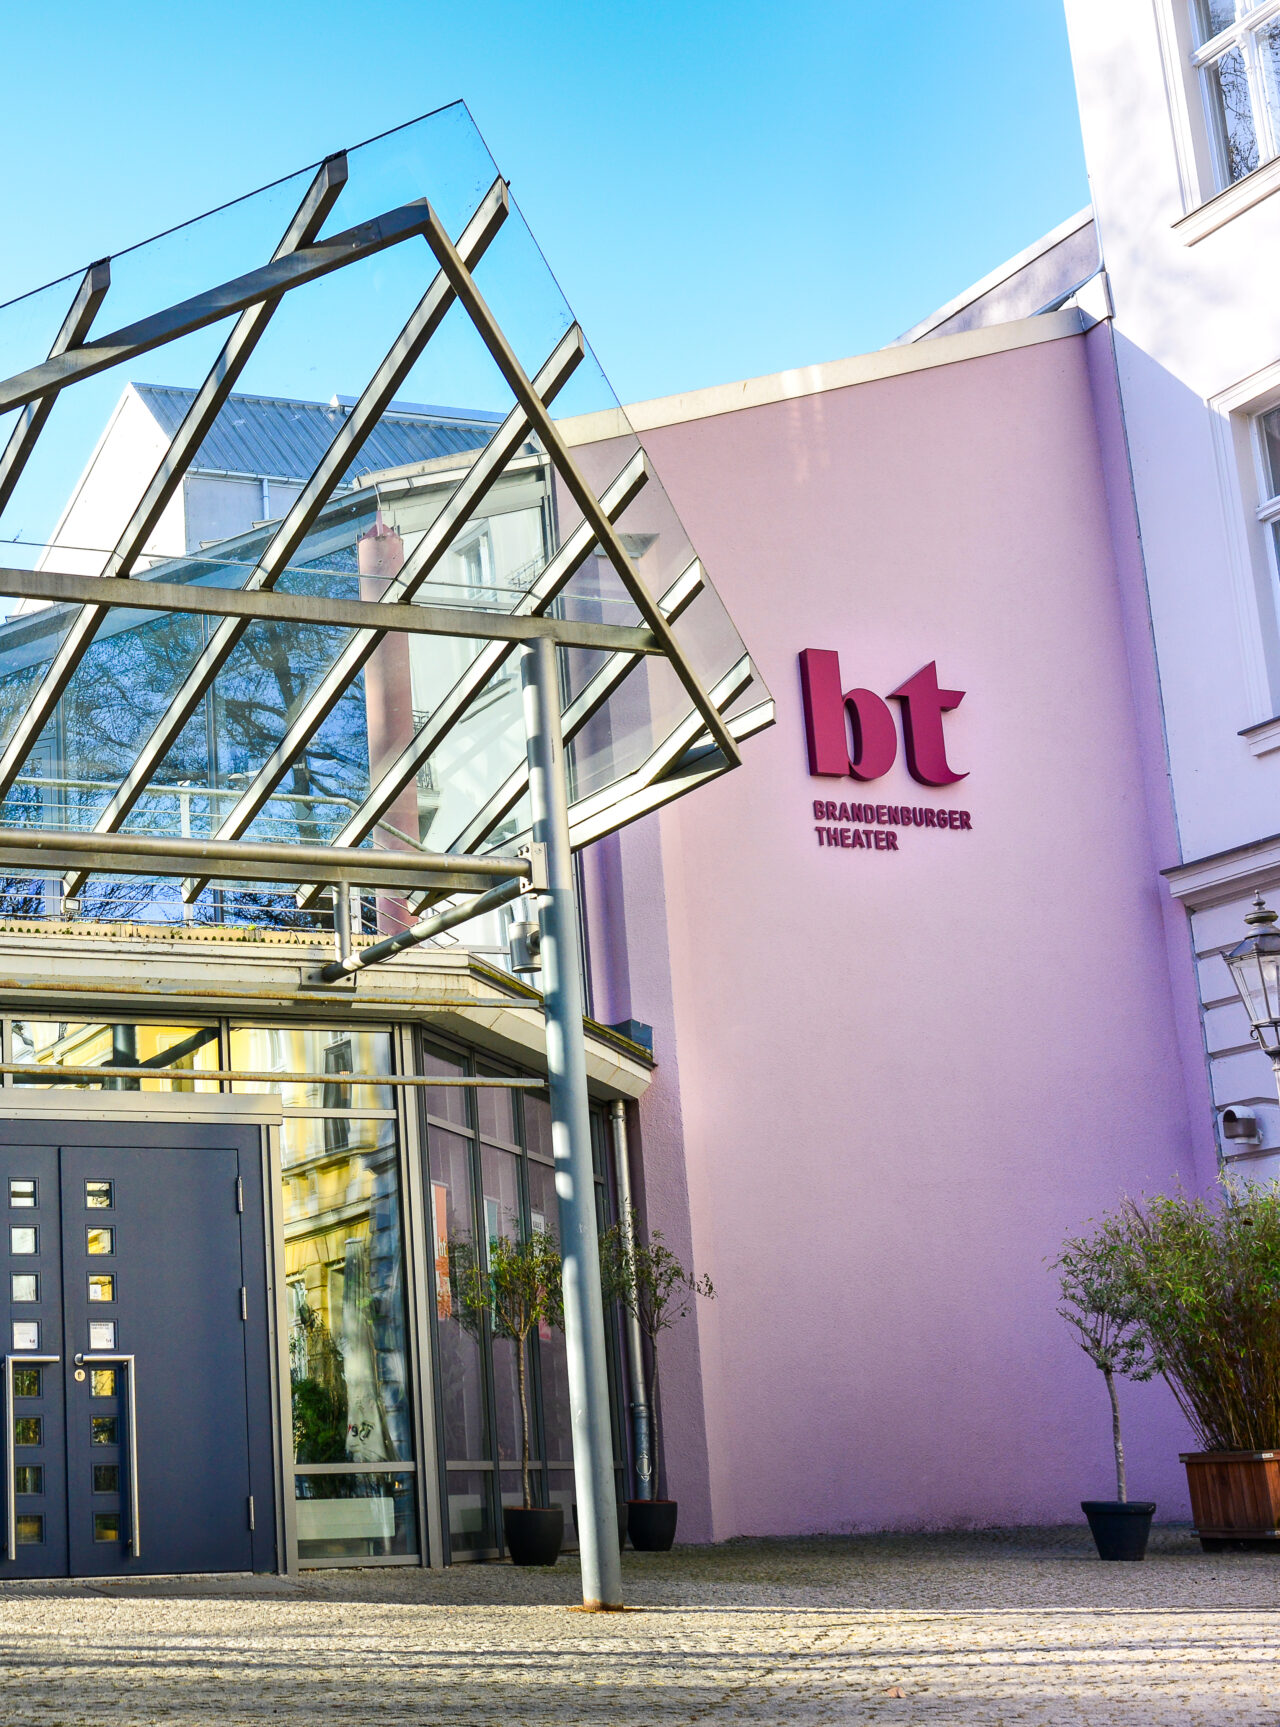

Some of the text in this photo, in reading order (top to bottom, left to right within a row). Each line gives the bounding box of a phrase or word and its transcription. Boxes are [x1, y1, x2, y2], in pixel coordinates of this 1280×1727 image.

[798, 648, 970, 787] bt
[813, 800, 972, 829] BRANDENBURGER
[815, 827, 899, 850] THEATER
